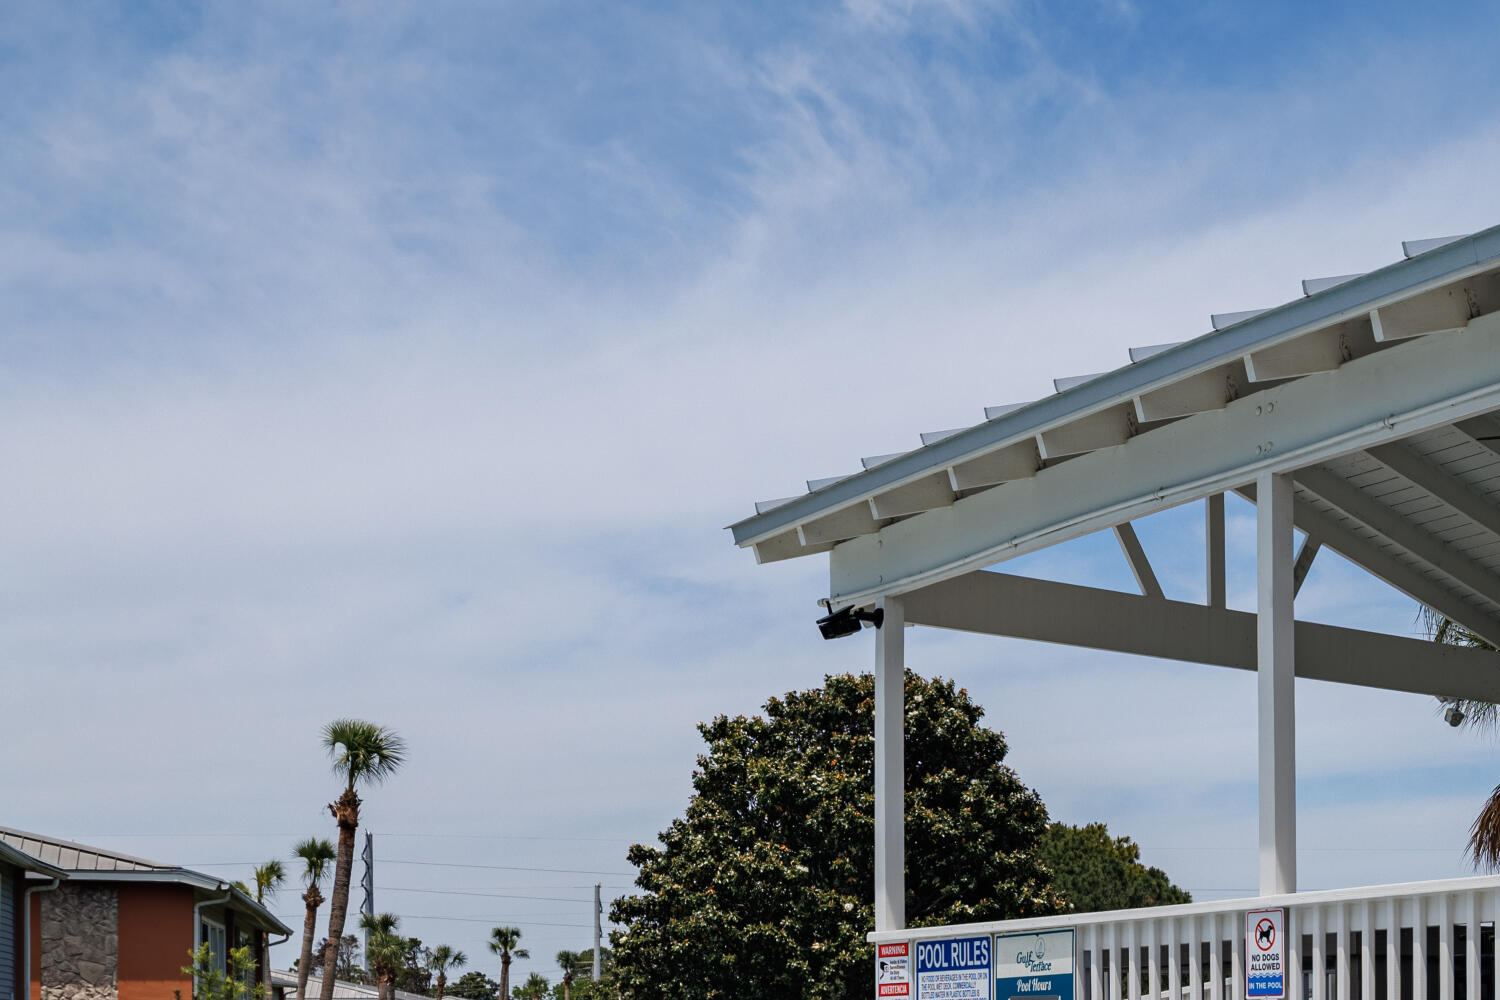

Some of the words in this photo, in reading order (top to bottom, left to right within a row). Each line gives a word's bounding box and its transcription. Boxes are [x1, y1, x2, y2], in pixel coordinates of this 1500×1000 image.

[881, 945, 905, 955] WARNING
[918, 943, 949, 969] POOL
[951, 940, 988, 967] RULES
[1016, 951, 1035, 968] Gulf
[1252, 954, 1261, 962] NO
[1262, 953, 1279, 961] DOGS
[1030, 961, 1052, 972] Terrace
[1251, 962, 1280, 971] ALLOWED
[880, 984, 907, 995] ADVERTENCIA
[1016, 978, 1031, 992] Pool
[1031, 977, 1052, 991] Hours
[1267, 981, 1282, 989] POOL
